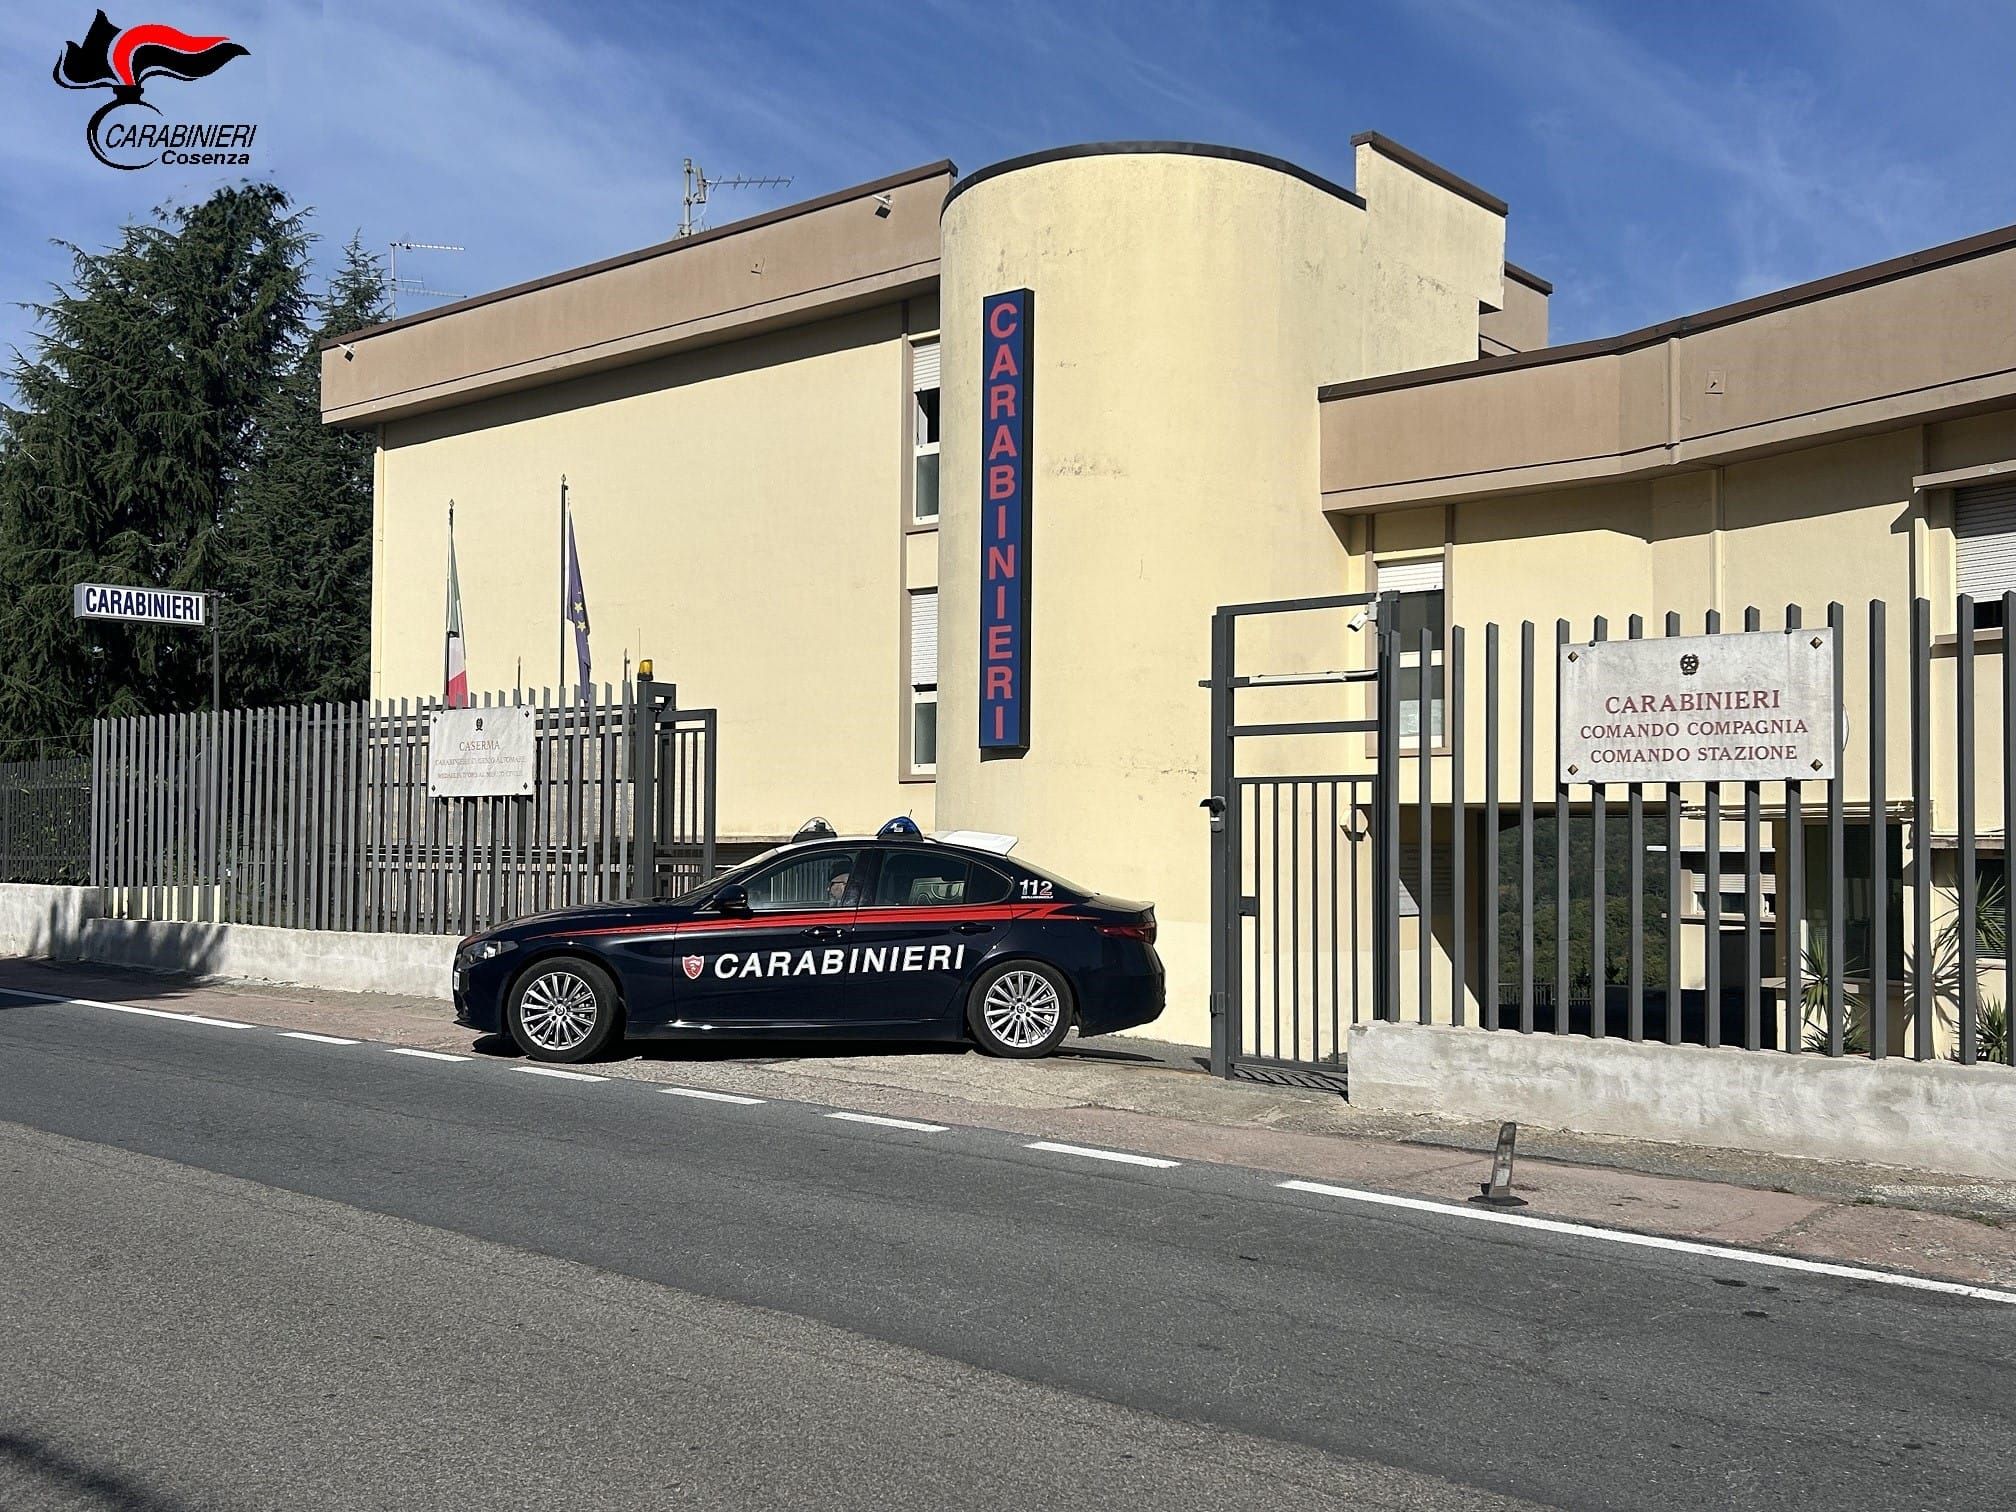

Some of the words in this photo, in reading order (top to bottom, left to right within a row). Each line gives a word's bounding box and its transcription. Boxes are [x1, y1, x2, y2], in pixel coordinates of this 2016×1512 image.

[985, 302, 1018, 740] CARABINIERI
[85, 587, 200, 621] CARABINIERI
[1604, 689, 1781, 715] CARABINIERI
[1580, 722, 1680, 740] COMANDO
[1687, 718, 1809, 737] COMPAGNIA
[458, 740, 501, 753] CASERMA
[1590, 748, 1691, 764] COMANDO
[1697, 745, 1798, 762] STAZIONE
[1019, 879, 1053, 896] 112
[713, 943, 966, 980] CARABINIERI
